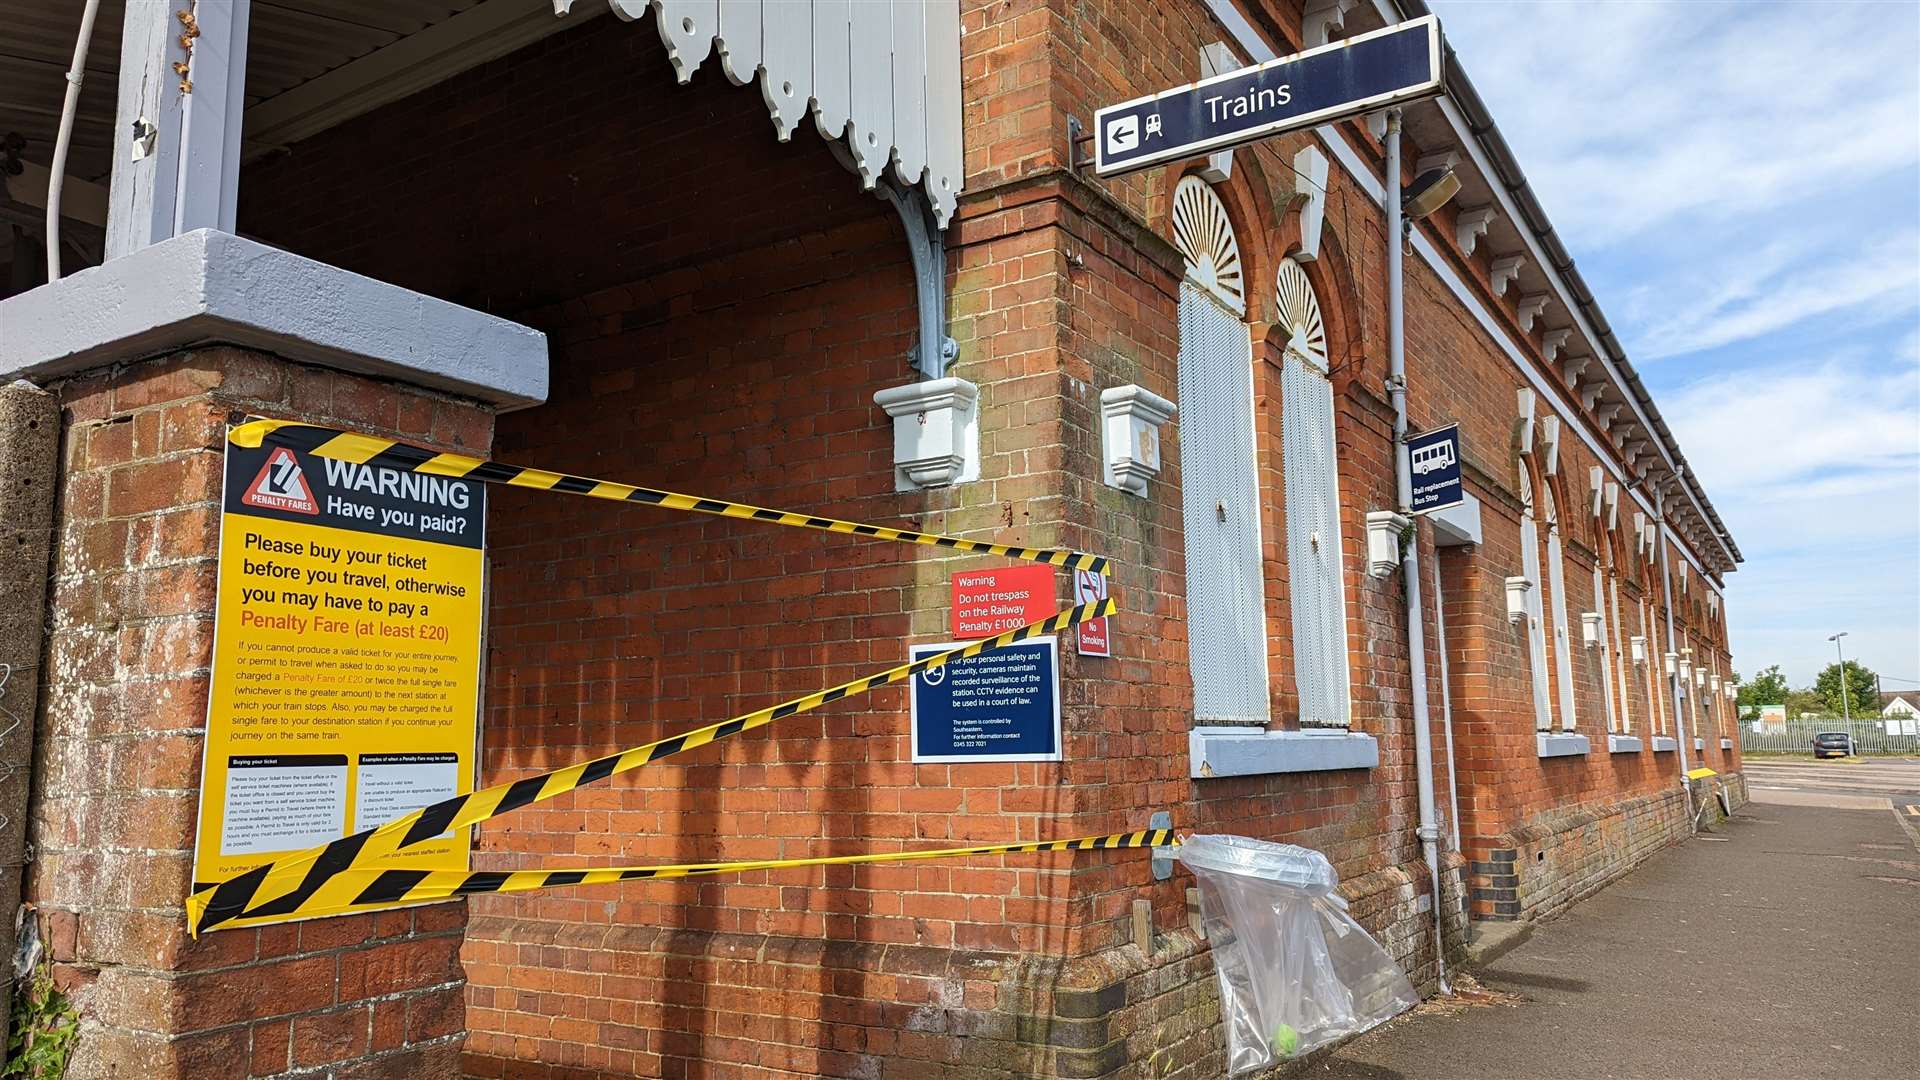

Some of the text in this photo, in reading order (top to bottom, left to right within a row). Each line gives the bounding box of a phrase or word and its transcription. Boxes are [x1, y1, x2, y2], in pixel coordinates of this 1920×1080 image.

[1204, 82, 1291, 124] Trains
[324, 457, 470, 510] WARNING
[1414, 477, 1459, 495] Rail replacement
[252, 494, 312, 511] PENALTY FARES
[1415, 494, 1438, 505] Bus Stop
[327, 496, 467, 535] Have you paid?
[244, 533, 427, 571] Please buy your ticket
[244, 559, 466, 598] before you travel, otherwise
[959, 576, 996, 588] Warning
[242, 588, 428, 617] you may have to pay a
[959, 591, 1030, 604] Do not trespass
[959, 605, 1025, 618] on the Railway
[241, 610, 449, 644] Penalty Fare (at least £20)
[960, 618, 1026, 633] Penalty £1000
[1089, 623, 1097, 632] No
[1082, 635, 1105, 649] Smoking
[239, 641, 244, 649] If
[247, 642, 263, 651] you
[266, 644, 294, 652] cannot
[298, 645, 330, 656] produce
[342, 648, 358, 656] valid
[361, 649, 381, 657] ticket
[383, 650, 392, 658] for
[979, 654, 1005, 664] personal
[1007, 654, 1026, 662] safety
[1028, 652, 1040, 660] and
[249, 658, 276, 666] permit
[280, 658, 287, 666] to
[291, 659, 313, 667] travel
[316, 660, 337, 668] when
[340, 662, 363, 670] asked
[375, 663, 384, 671] do
[413, 666, 427, 674] may
[430, 666, 438, 674] be
[952, 667, 978, 676] security,
[979, 666, 1006, 674] cameras
[236, 672, 272, 682] charged
[284, 673, 314, 684] Penalty
[317, 674, 335, 683] Fare
[338, 675, 345, 683] of
[410, 678, 420, 686] full
[422, 680, 442, 688] single
[952, 678, 981, 686] recorded
[235, 687, 282, 696] (whichever
[295, 688, 308, 696] the
[341, 690, 373, 699] amount)
[415, 692, 437, 700] station
[952, 689, 976, 697] station.
[995, 687, 1024, 695] evidence
[233, 701, 259, 709] which
[305, 703, 328, 712] stops.
[400, 705, 428, 714] charged
[1010, 697, 1017, 705] of
[232, 716, 257, 726] single
[292, 718, 309, 726] your
[313, 717, 355, 725] destination
[392, 719, 405, 727] you
[439, 719, 453, 727] your
[231, 732, 263, 741] journey
